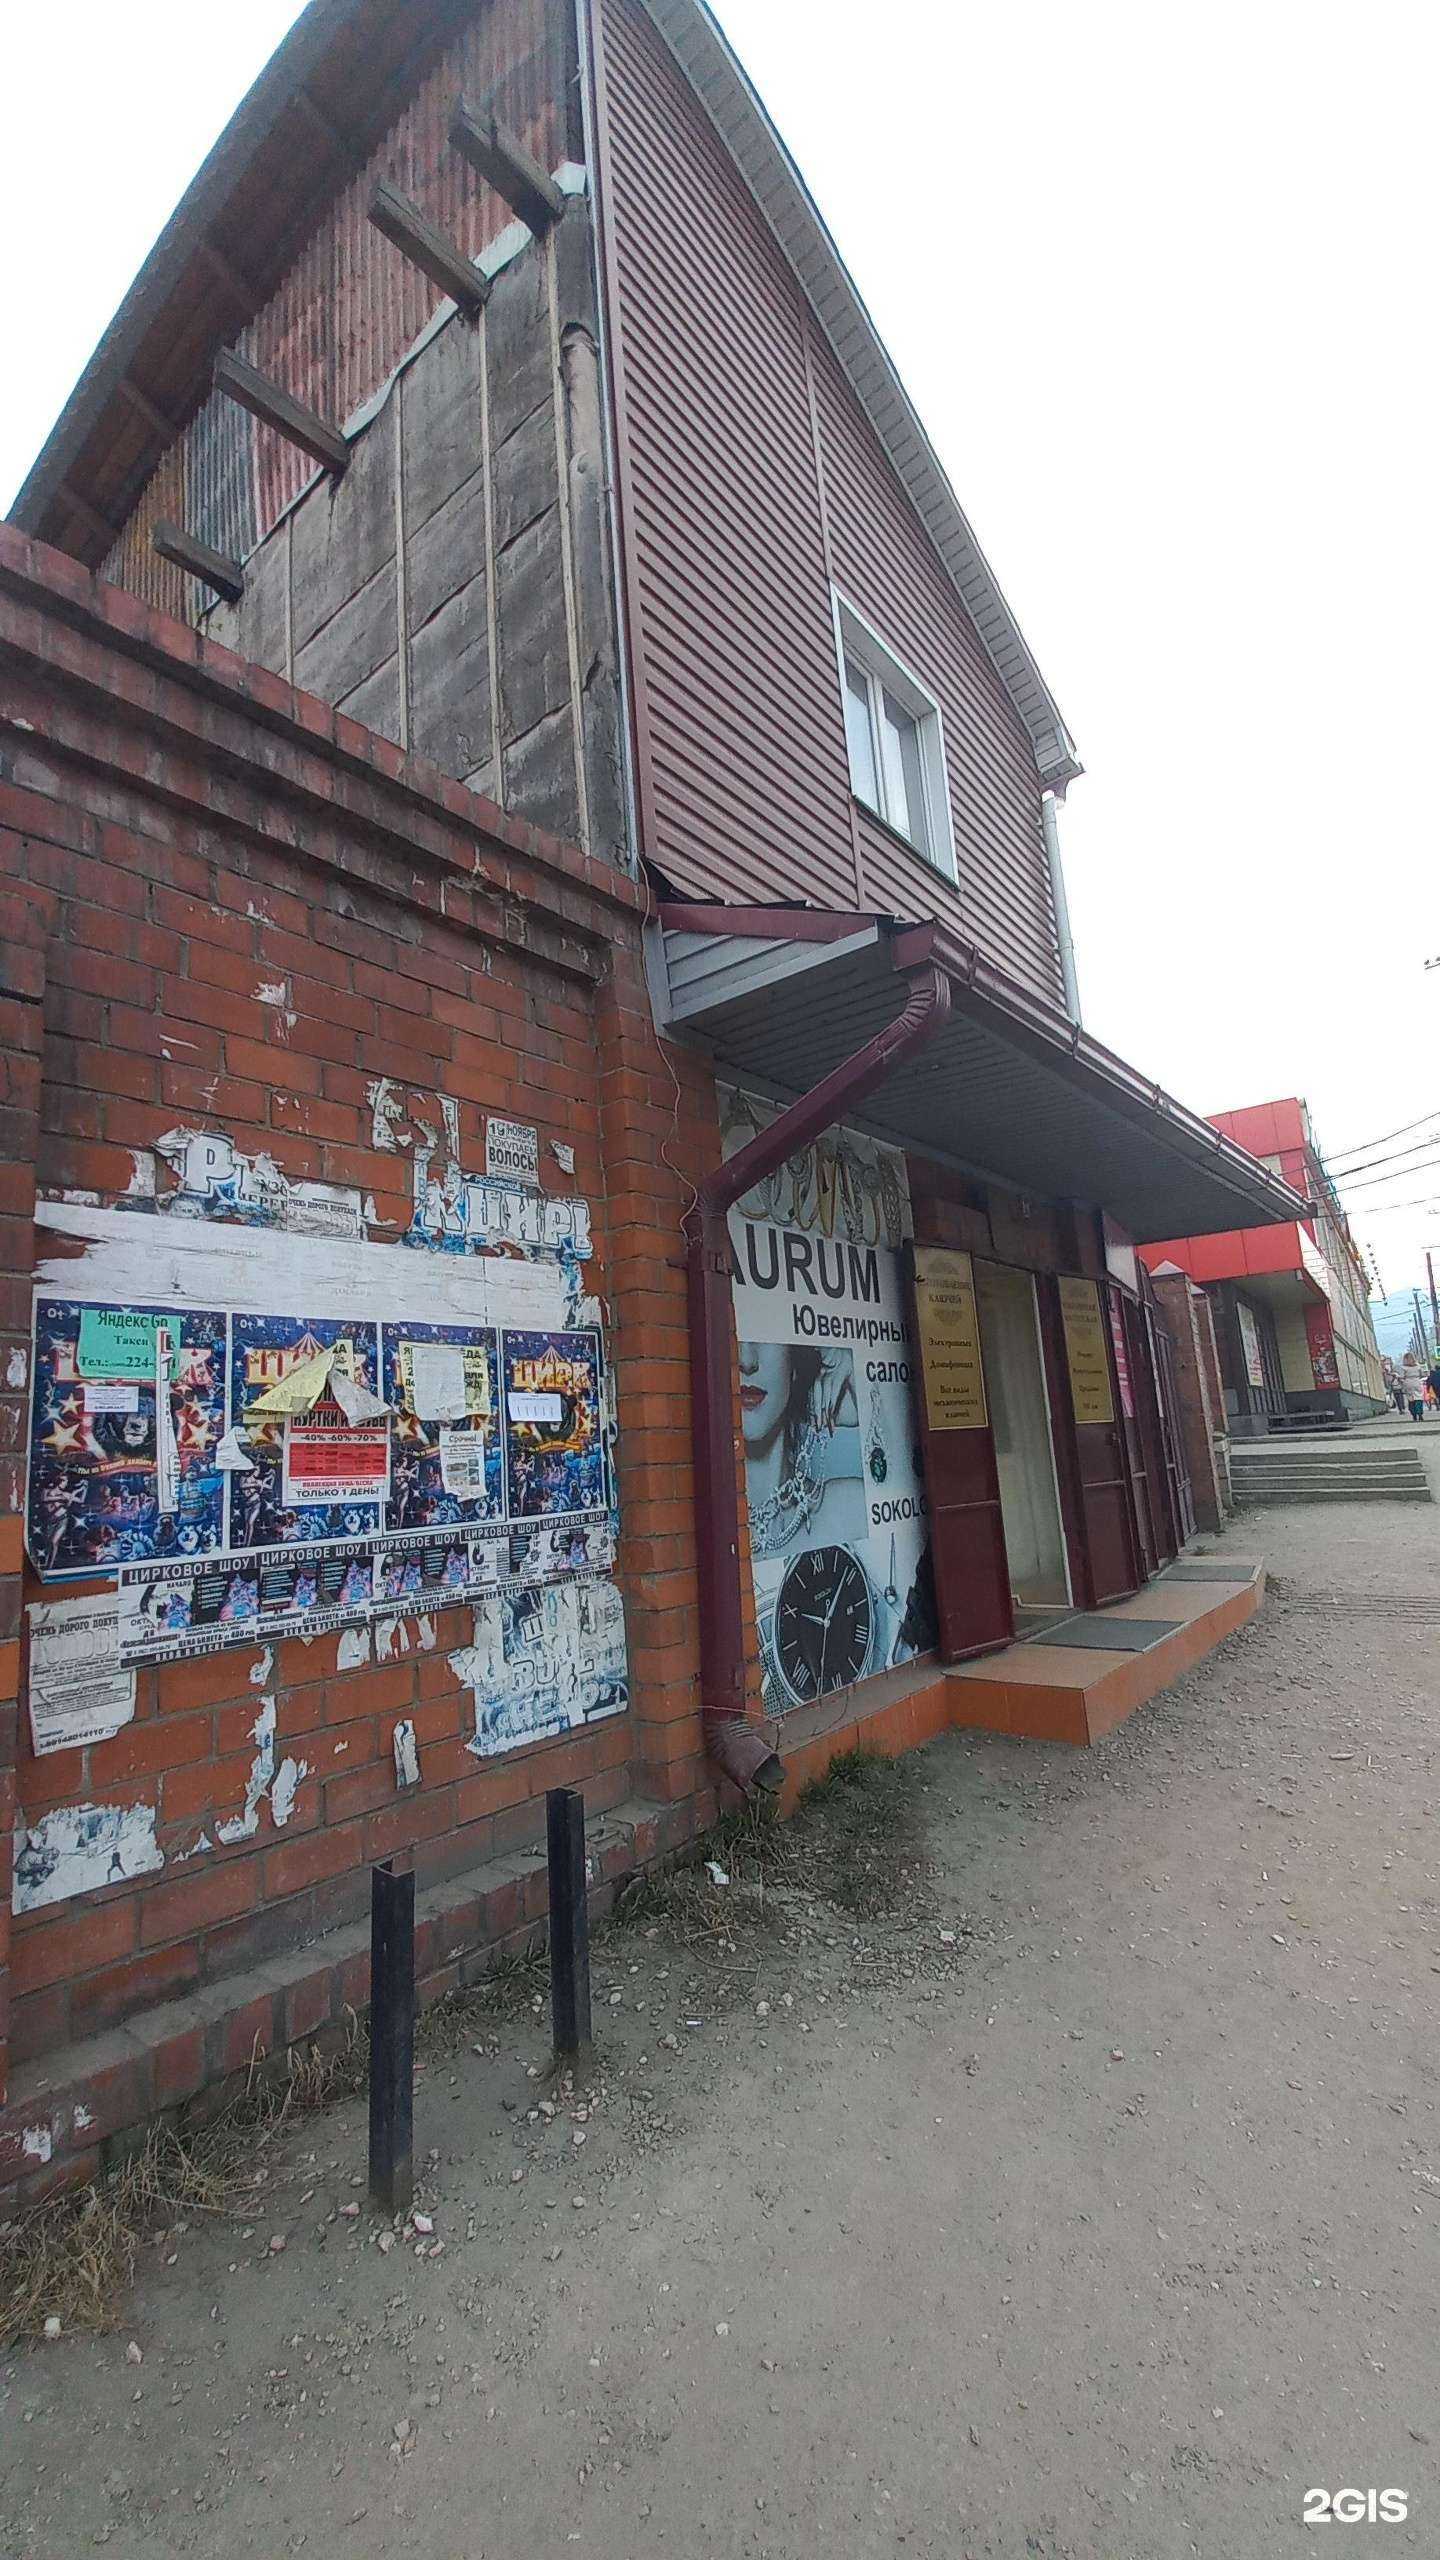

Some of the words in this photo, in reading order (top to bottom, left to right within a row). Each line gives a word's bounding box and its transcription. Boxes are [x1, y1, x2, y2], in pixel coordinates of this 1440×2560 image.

[488, 1122, 505, 1136] 19
[506, 1126, 537, 1140] НОЯБРЯ
[488, 1138, 538, 1156] ПОКУПАЕМ
[488, 1146, 539, 1172] ВОЛОСЫ
[97, 1310, 150, 1329] Яндекс
[792, 1303, 908, 1348] Ювелирны
[113, 1334, 149, 1346] Такси
[866, 1360, 911, 1383] сало
[296, 1488, 340, 1498] ТОЛЬКО
[349, 1488, 380, 1497] ДЕНЬ!
[542, 1515, 586, 1529] ЦИРКОВОЕ
[588, 1511, 606, 1521] ШОУ
[464, 1526, 516, 1541] ЦИРКОВОЕ
[517, 1523, 537, 1535] ШОУ
[372, 1537, 431, 1554] ЦИРКОВОЕ
[434, 1534, 458, 1545] ШОУ
[261, 1547, 331, 1566] ЦИРКОВОЕ
[335, 1543, 362, 1557] ШОУ
[128, 1563, 213, 1584] ЦИРКОВОЕ
[217, 1557, 250, 1573] ШОУ
[58, 1619, 90, 1635] ДОРОГО
[92, 1615, 119, 1629] ПОКУП
